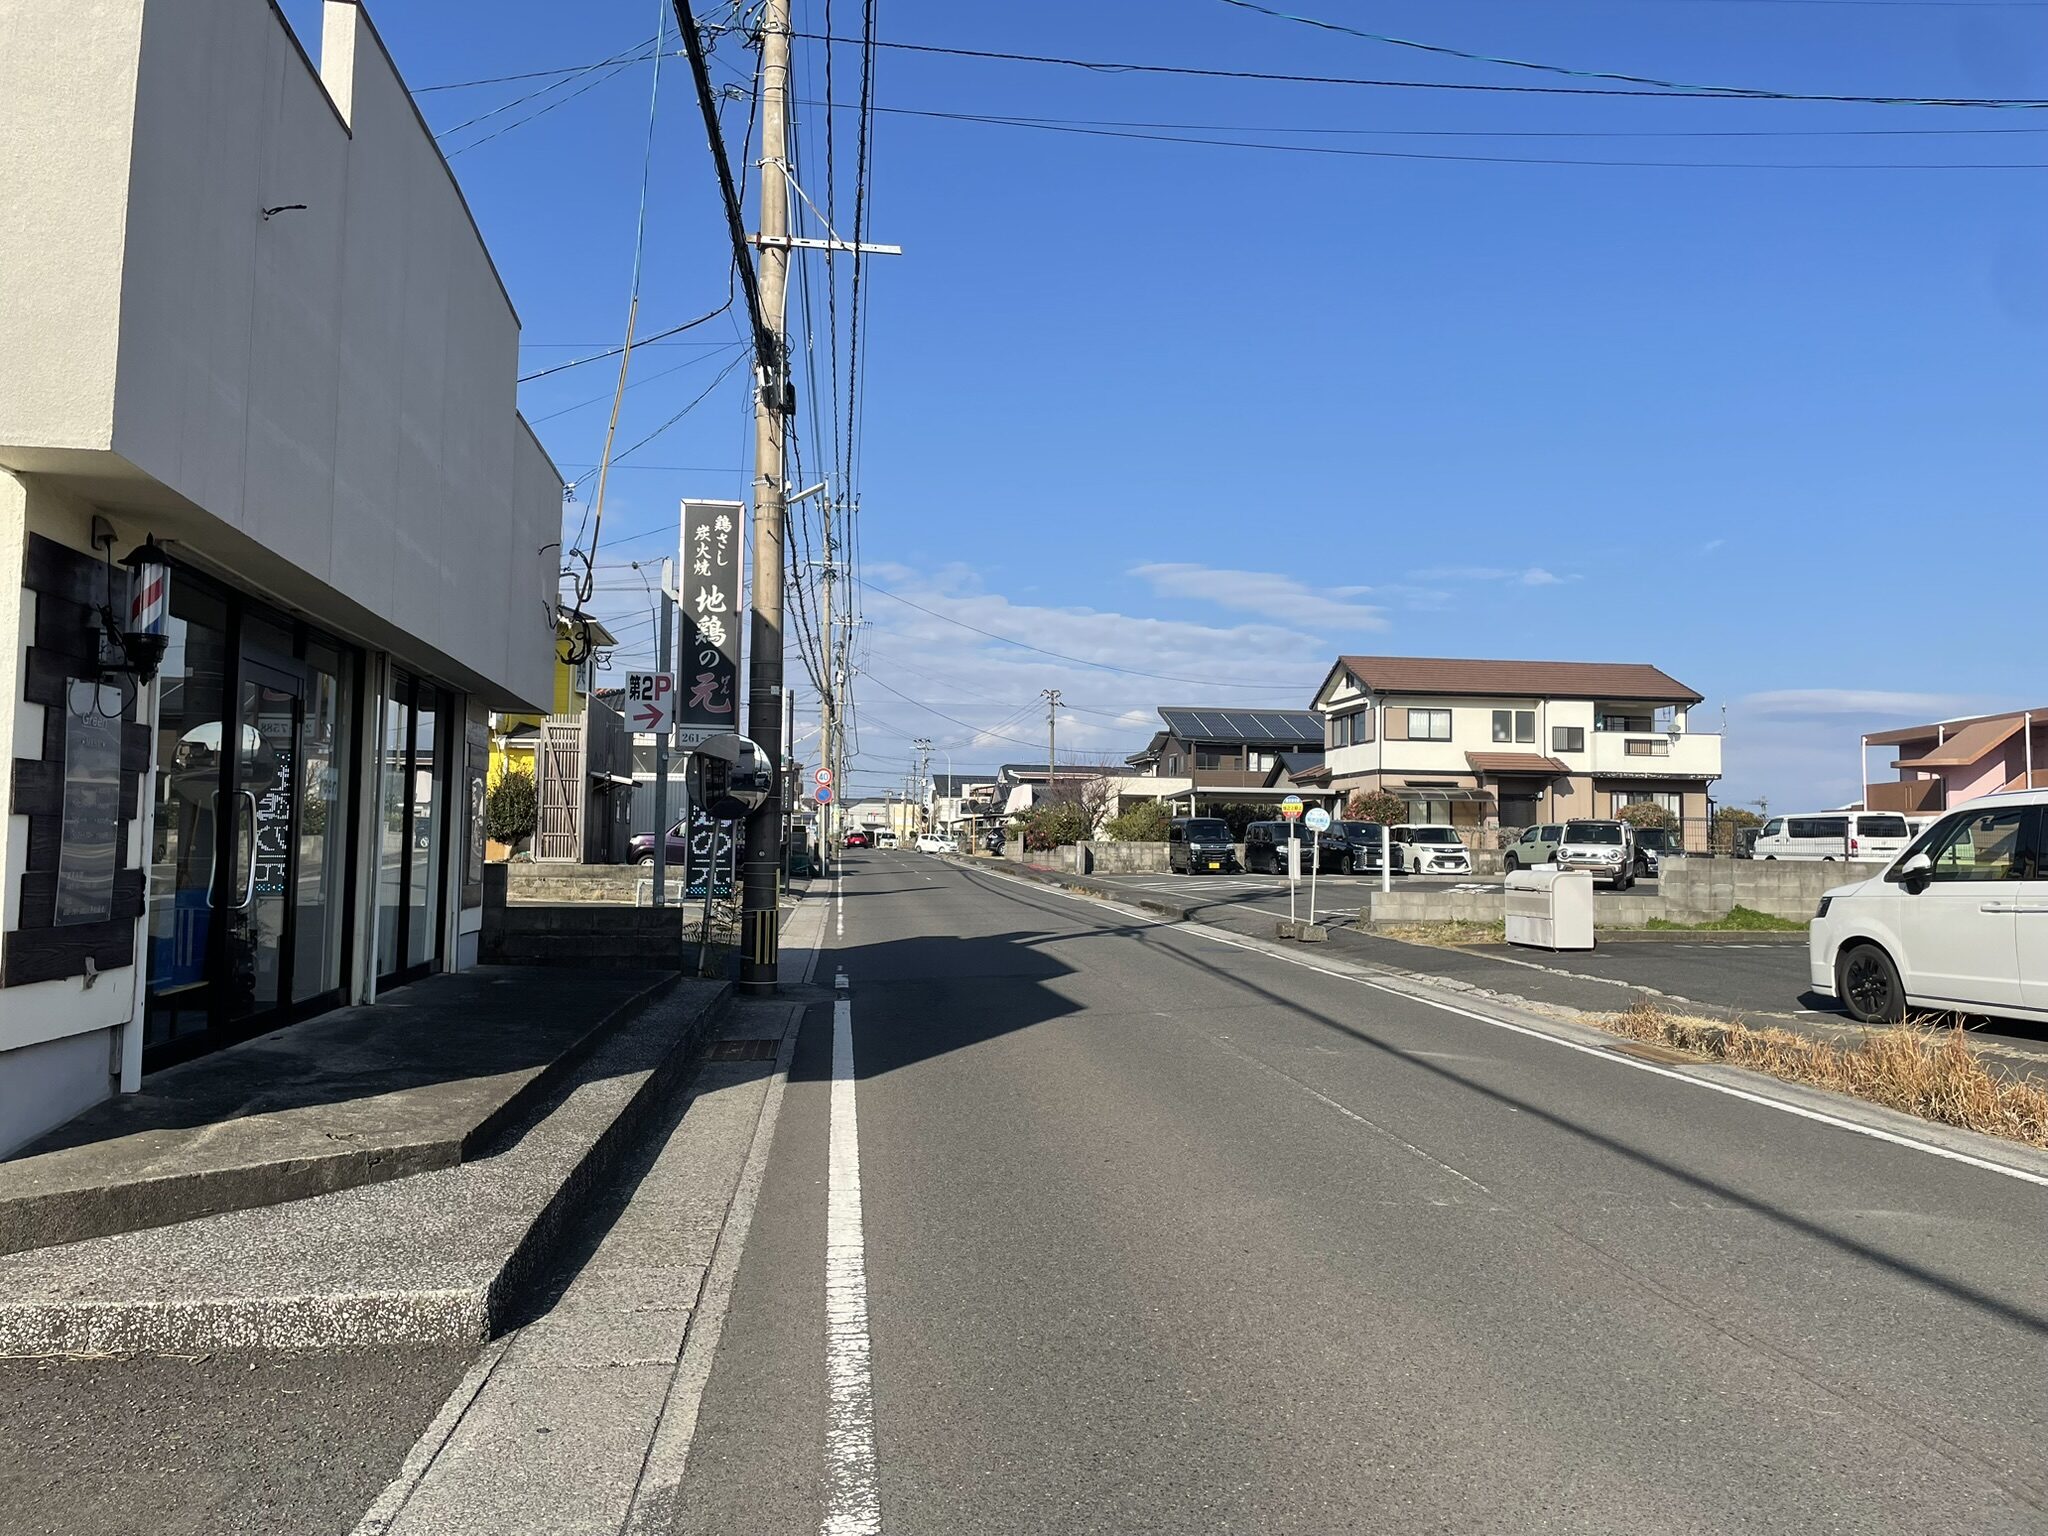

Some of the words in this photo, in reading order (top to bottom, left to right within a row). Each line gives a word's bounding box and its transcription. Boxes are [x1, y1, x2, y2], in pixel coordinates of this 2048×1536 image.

[693, 524, 712, 577] 炭火焼
[714, 514, 732, 566] 鶏さし
[688, 584, 732, 713] 地鶏の元
[629, 674, 671, 701] 第2P
[720, 674, 731, 695] げん
[819, 773, 829, 781] 40
